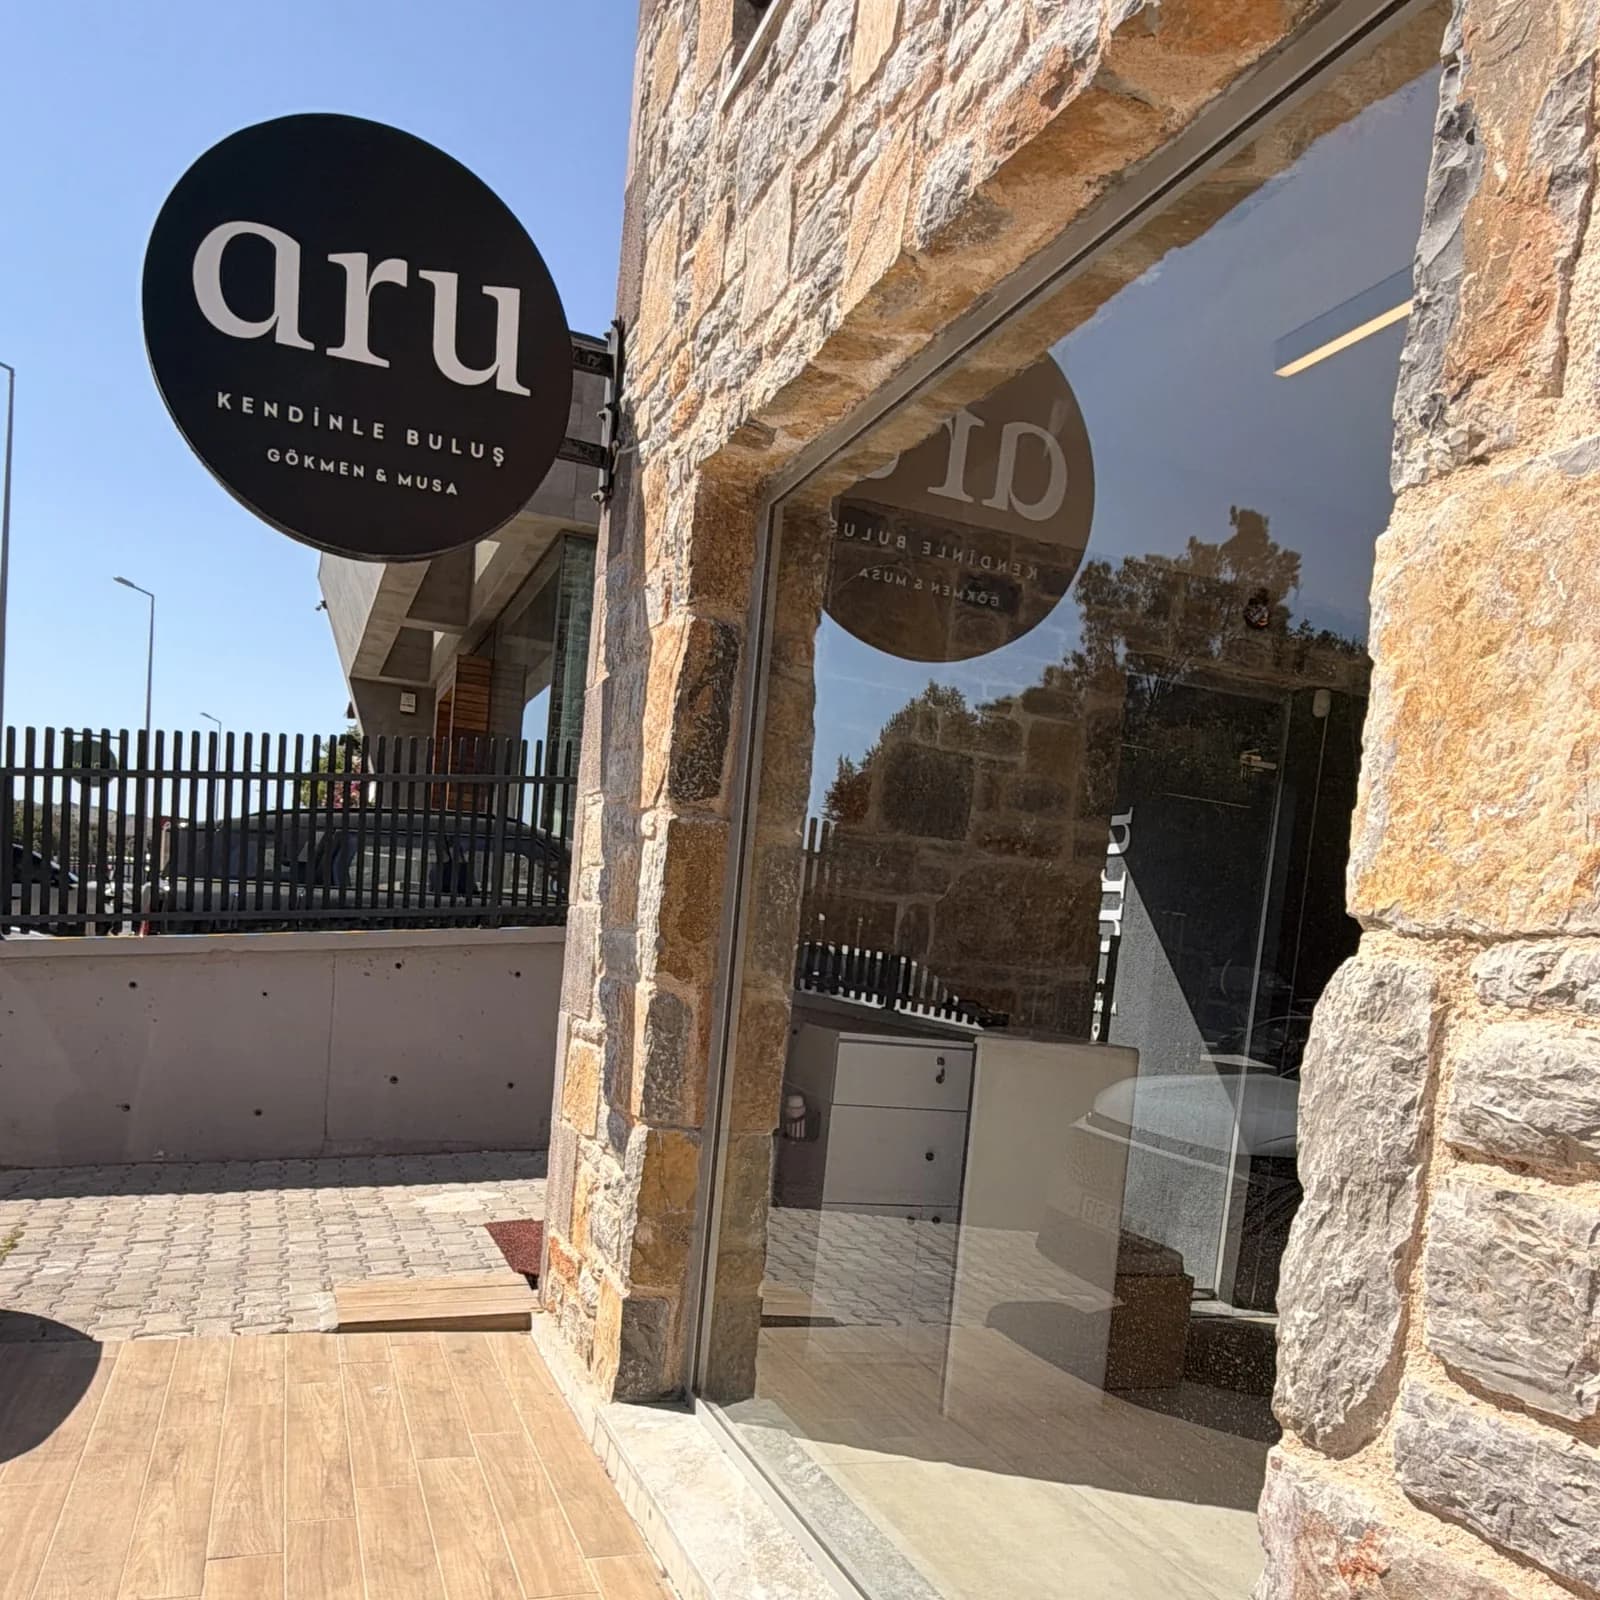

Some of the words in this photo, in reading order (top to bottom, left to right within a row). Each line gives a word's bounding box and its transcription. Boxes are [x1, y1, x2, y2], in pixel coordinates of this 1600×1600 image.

[192, 219, 532, 397] aru
[216, 391, 385, 440] KENDİNLE
[406, 428, 506, 467] BULUŞ
[266, 448, 365, 478] GÖKMEN
[375, 468, 388, 483] &
[397, 473, 459, 496] MUSA
